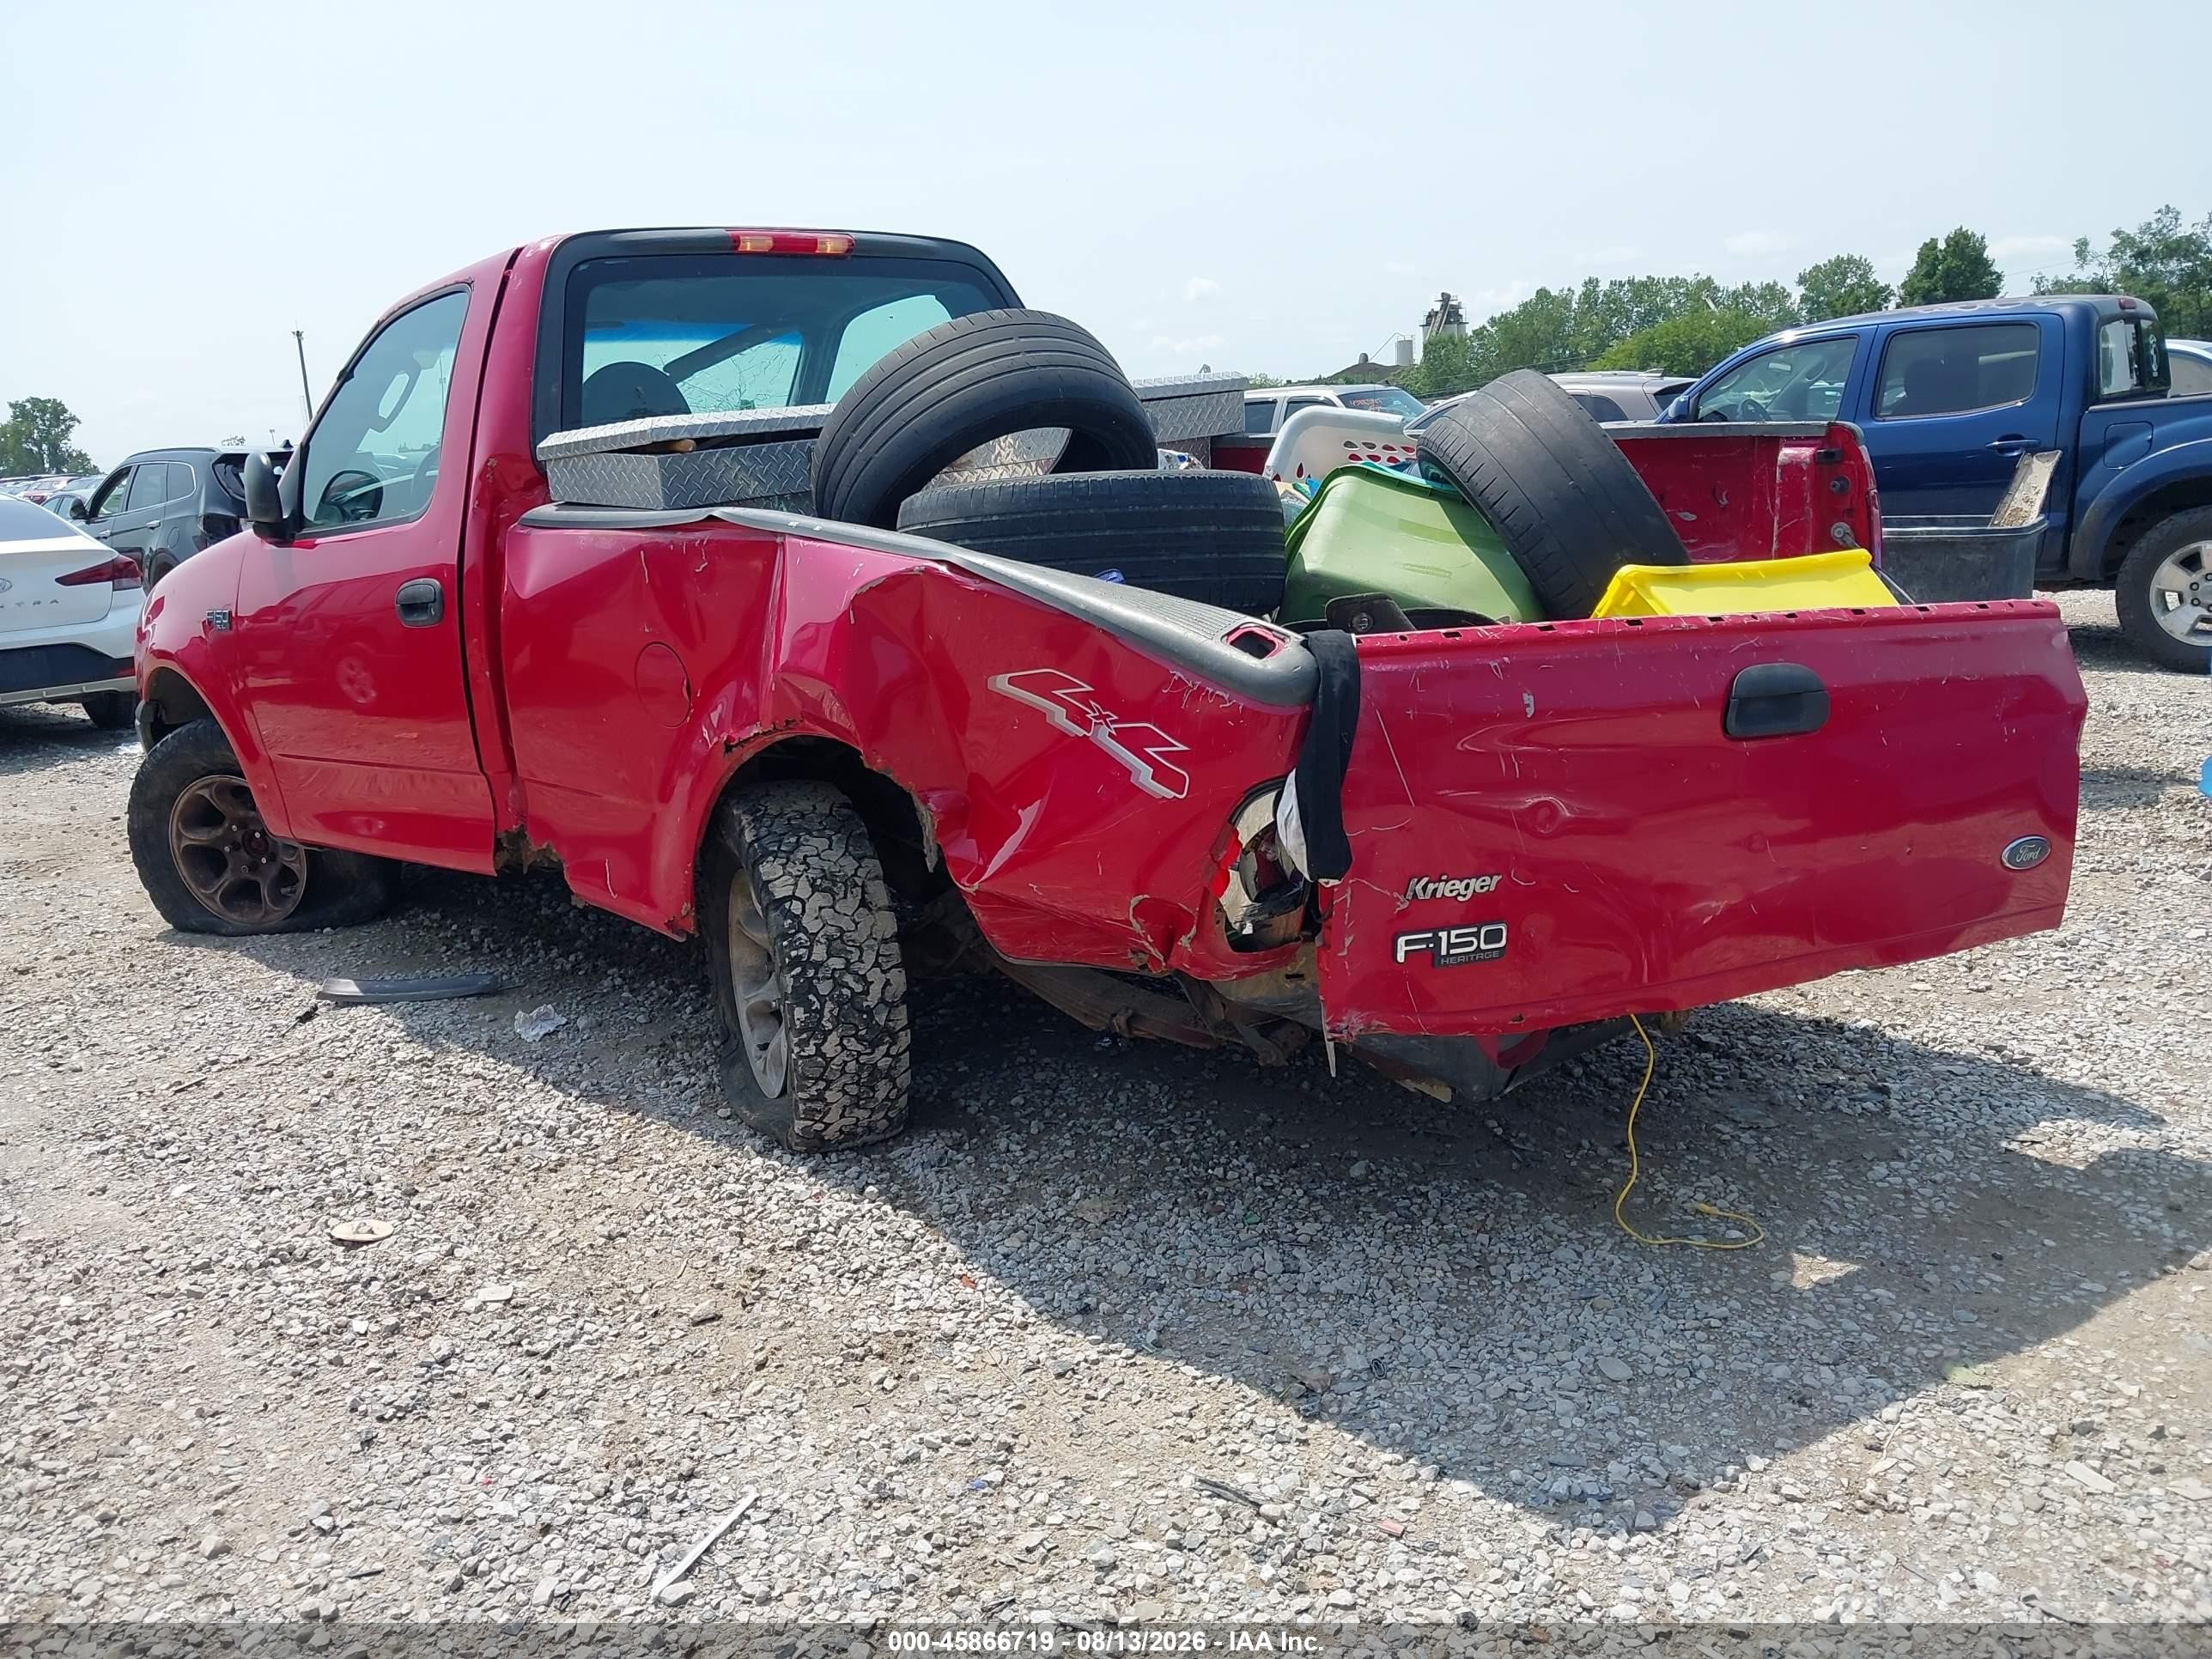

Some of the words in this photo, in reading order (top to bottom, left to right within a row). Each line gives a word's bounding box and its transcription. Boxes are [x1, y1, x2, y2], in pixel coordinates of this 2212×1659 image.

[2015, 844, 2042, 863] Ford
[1406, 874, 1503, 902] Krieger
[1440, 950, 1501, 966] HERITAGE
